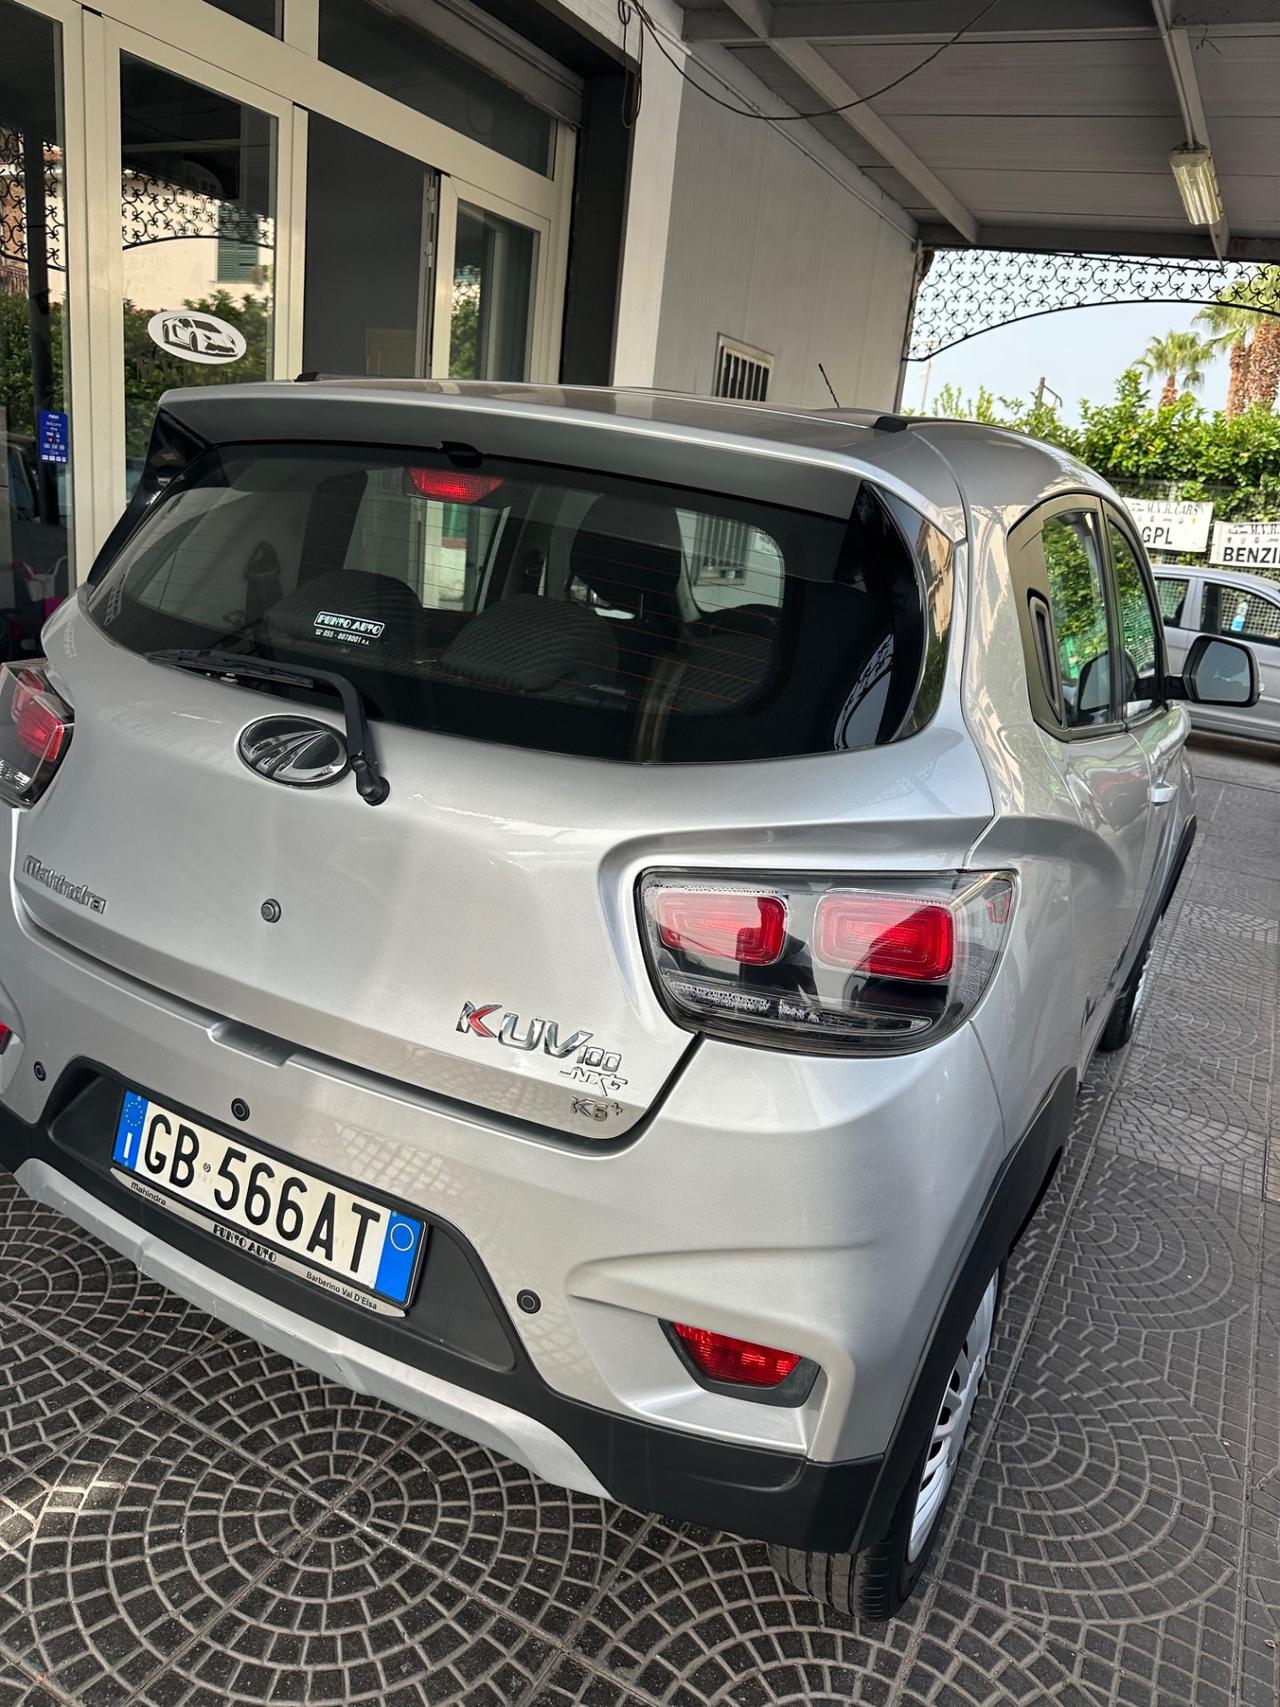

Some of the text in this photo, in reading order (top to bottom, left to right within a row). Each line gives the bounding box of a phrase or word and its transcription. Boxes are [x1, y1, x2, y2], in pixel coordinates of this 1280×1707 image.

[1142, 526, 1173, 545] GPL
[1222, 546, 1280, 564] BENZI
[317, 614, 381, 634] PUNTO AUTO
[213, 1223, 277, 1263] PUNTO AUTO
[306, 1271, 378, 1310] Barberino Val D'Elsa
